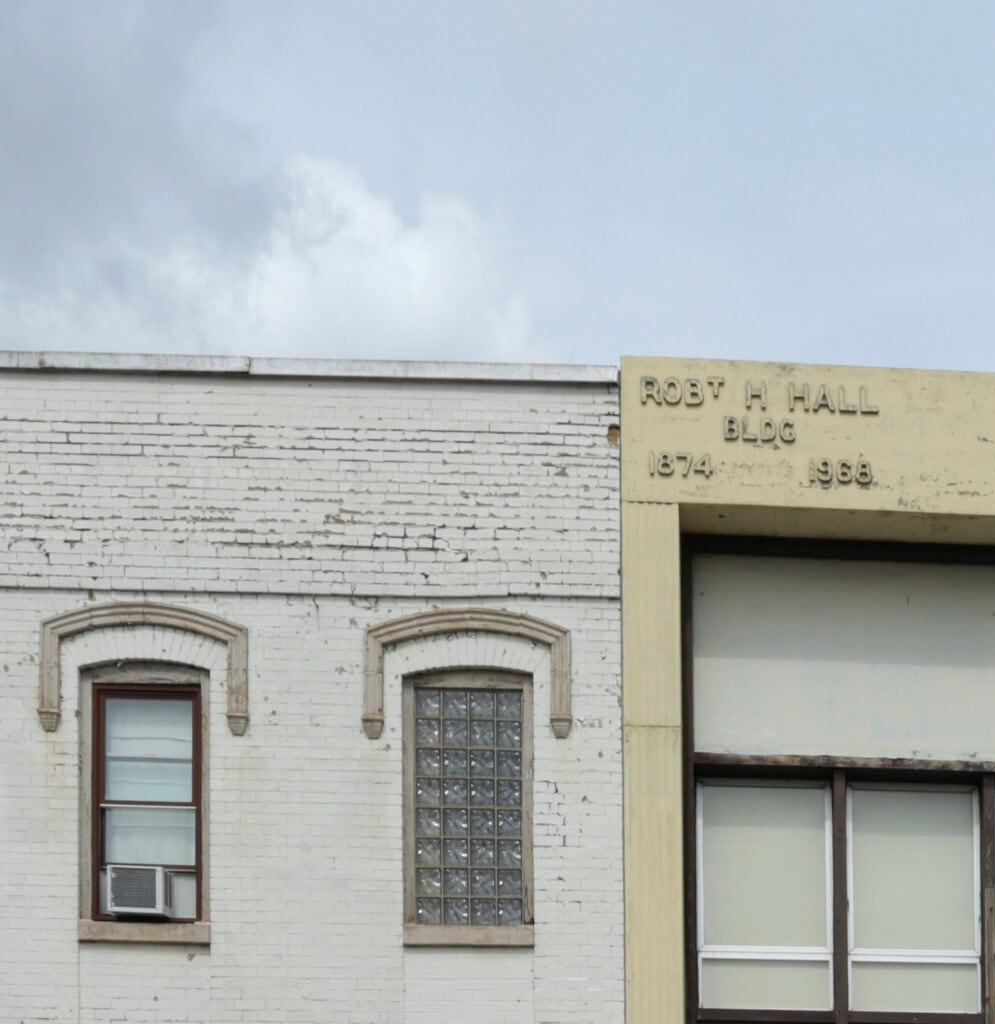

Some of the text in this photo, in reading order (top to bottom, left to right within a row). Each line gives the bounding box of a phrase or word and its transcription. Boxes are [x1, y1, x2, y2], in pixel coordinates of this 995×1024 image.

[745, 380, 768, 410] H
[788, 382, 879, 415] HALL
[723, 415, 797, 442] BLDG
[649, 451, 874, 485] 1874 1968
